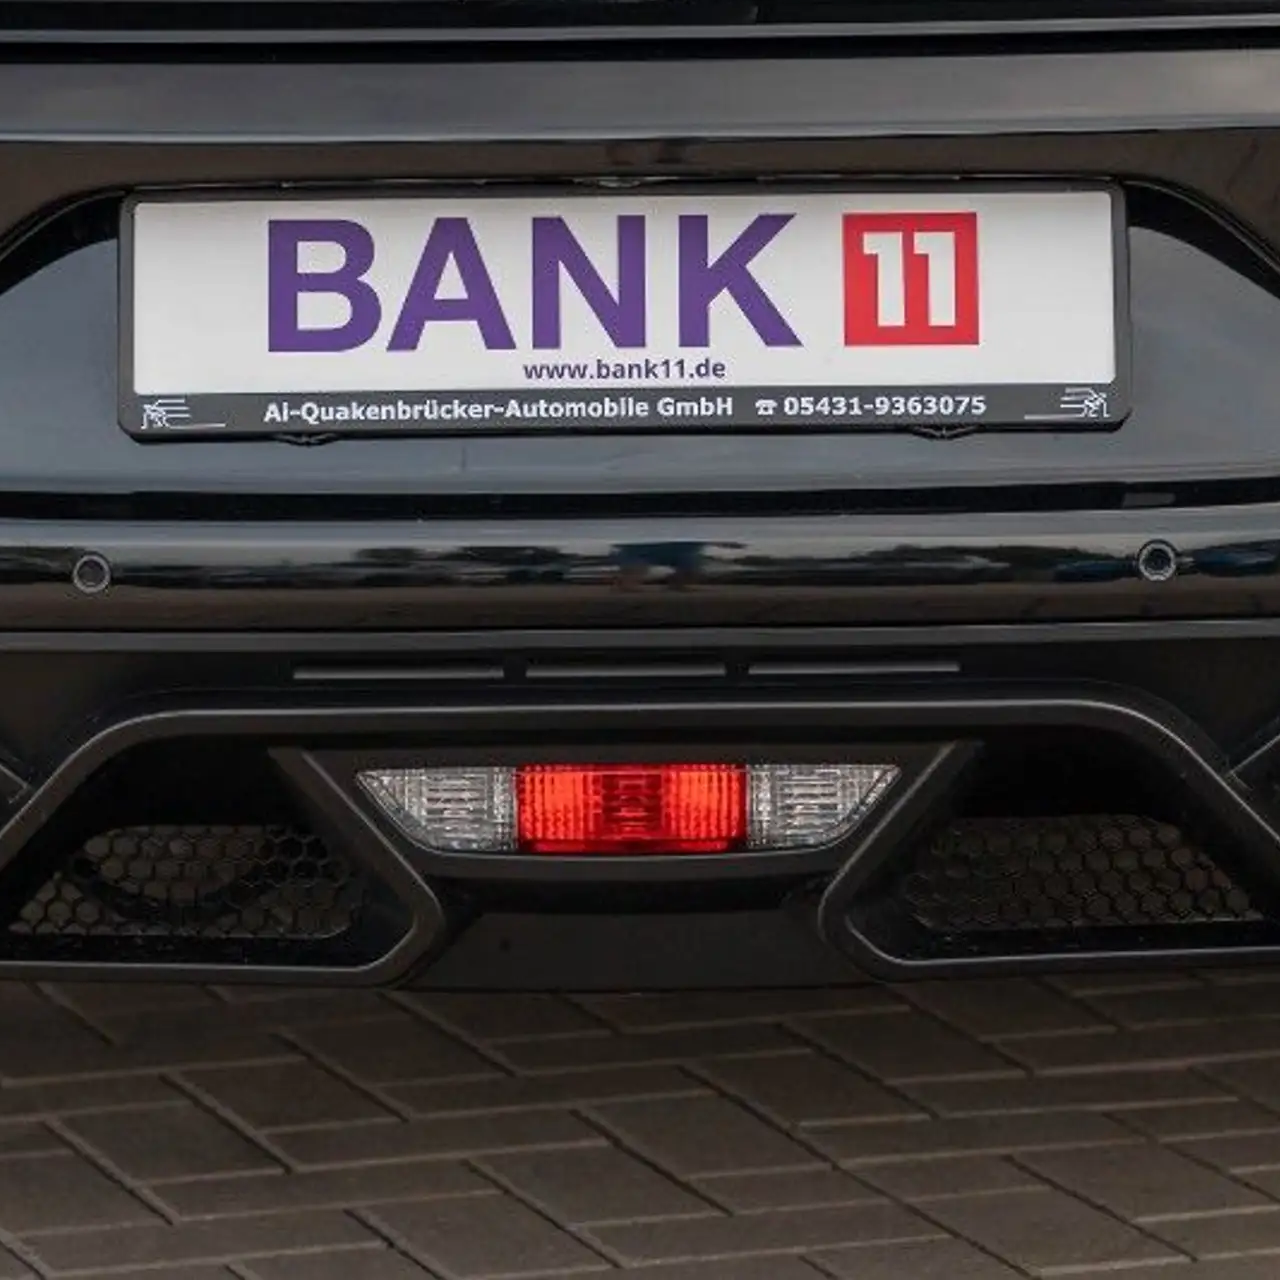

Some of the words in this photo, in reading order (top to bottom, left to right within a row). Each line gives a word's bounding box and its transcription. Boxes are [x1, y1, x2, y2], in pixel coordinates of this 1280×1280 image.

[267, 214, 803, 352] BANK
[863, 231, 956, 327] 11
[523, 360, 726, 380] www.bank11.de
[657, 398, 732, 417] GmbH
[784, 397, 986, 416] 05431-9363075
